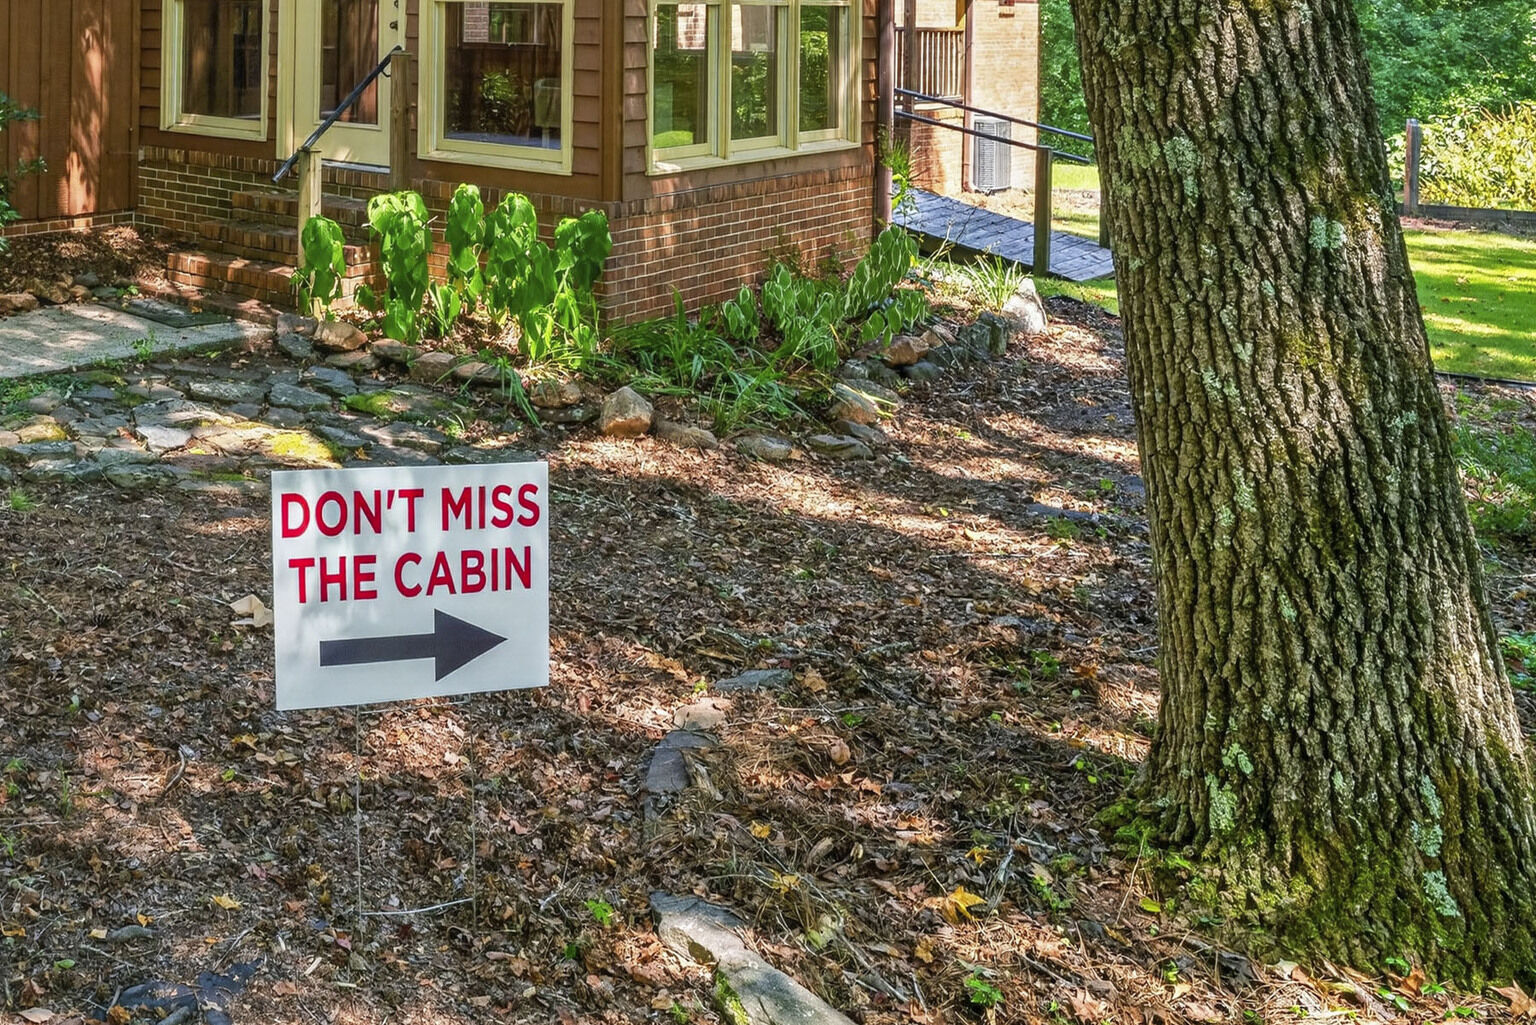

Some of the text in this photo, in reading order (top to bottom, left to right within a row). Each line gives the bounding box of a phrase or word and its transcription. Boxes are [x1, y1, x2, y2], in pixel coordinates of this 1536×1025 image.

[280, 483, 541, 539] DON'T MISS
[288, 545, 532, 604] THE CABIN
